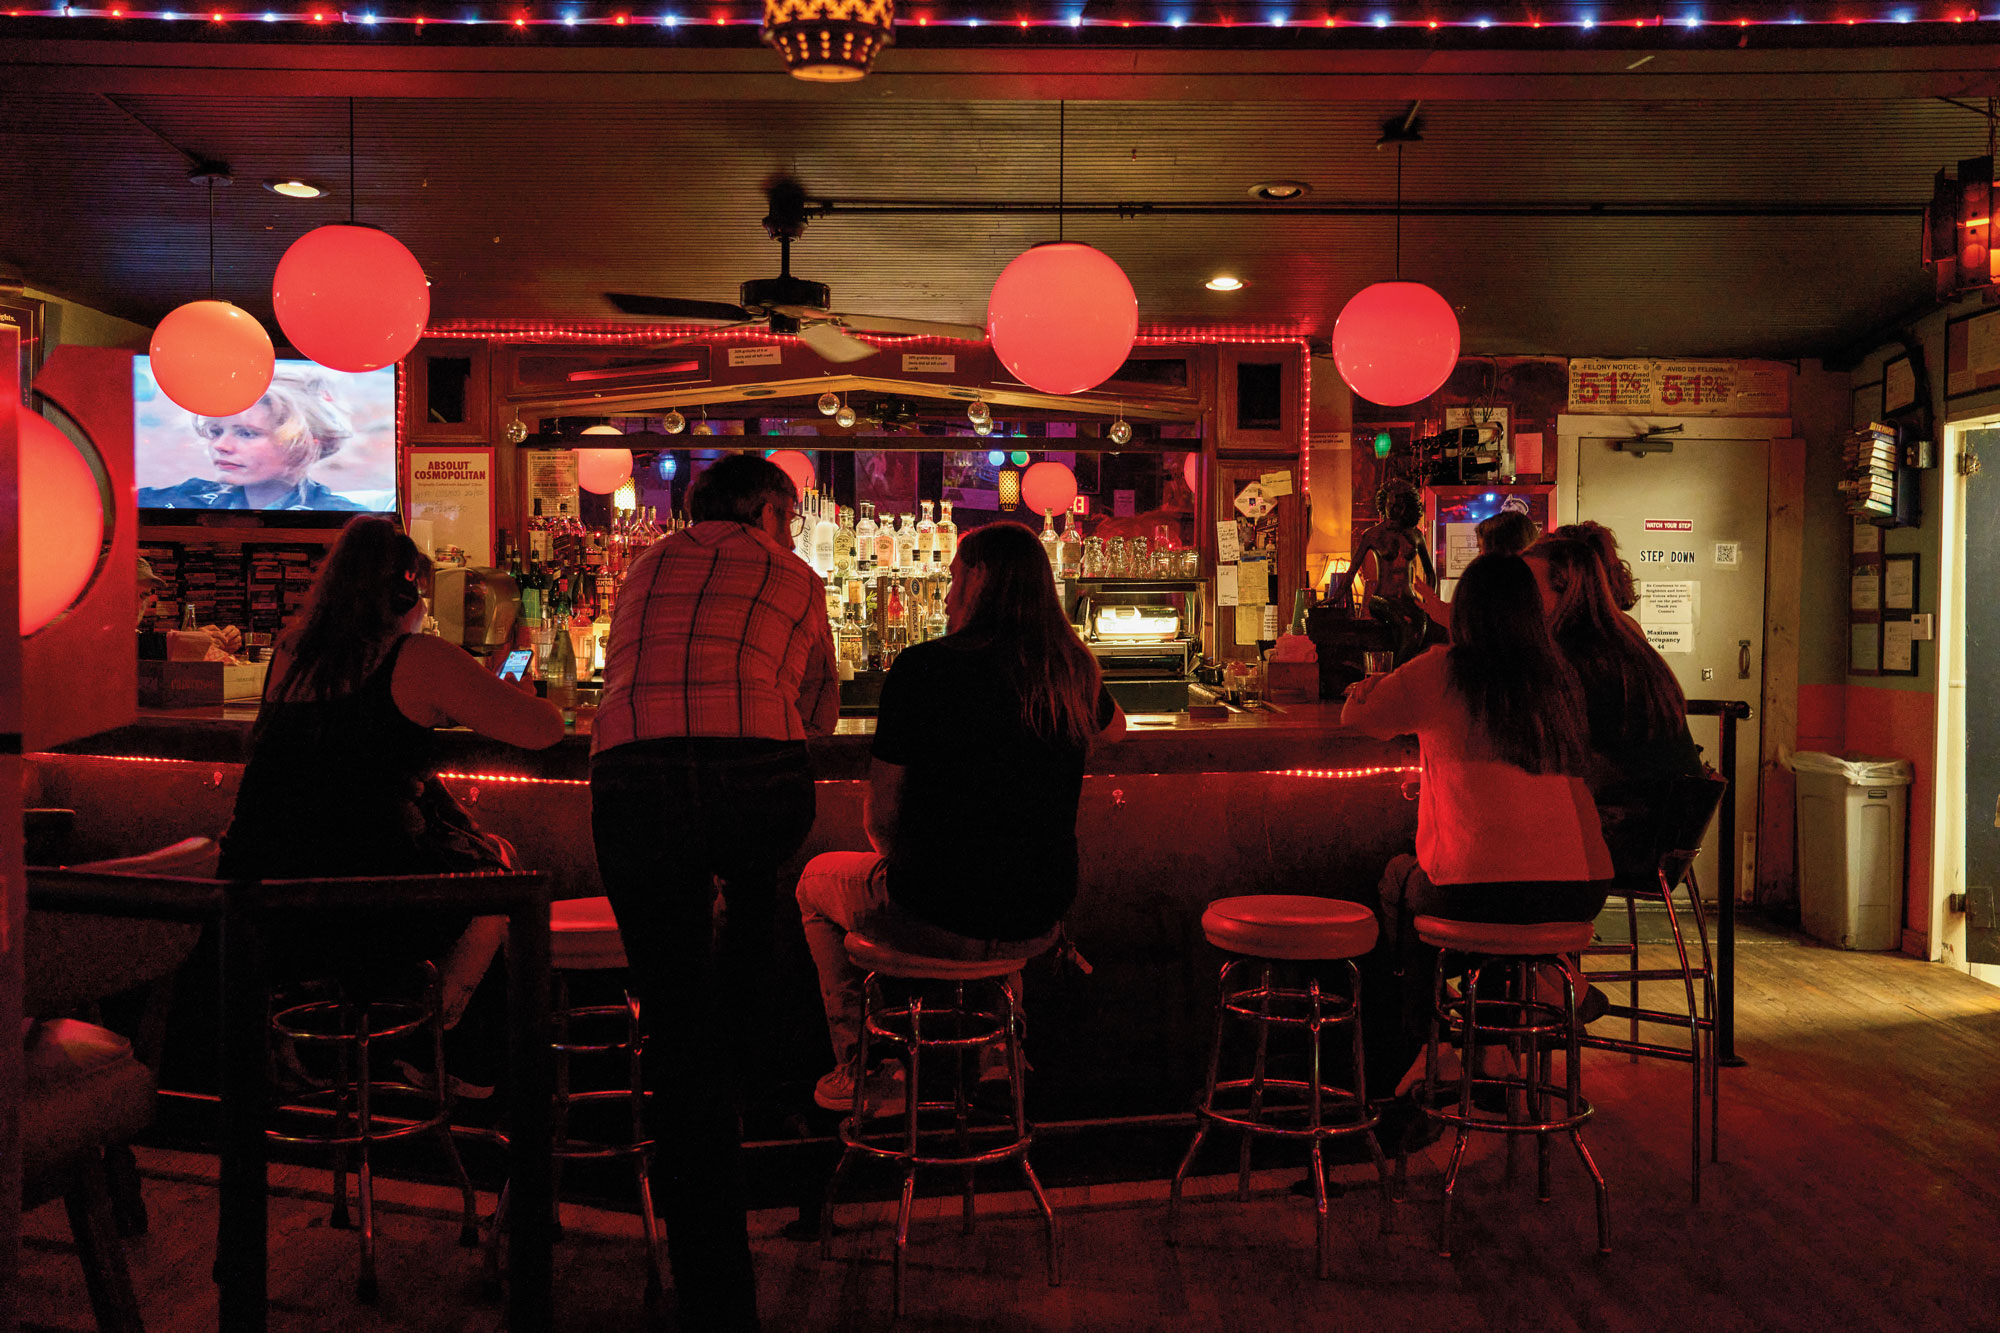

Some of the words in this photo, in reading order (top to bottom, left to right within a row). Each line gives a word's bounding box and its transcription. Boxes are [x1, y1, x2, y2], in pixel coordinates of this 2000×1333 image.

[1579, 372, 1641, 404] 51%
[1662, 374, 1725, 406] 51%
[428, 461, 469, 470] ABSOLUT
[414, 470, 486, 480] COSMOPOLITAN
[1640, 550, 1664, 562] STEP
[1670, 551, 1695, 563] DOWN
